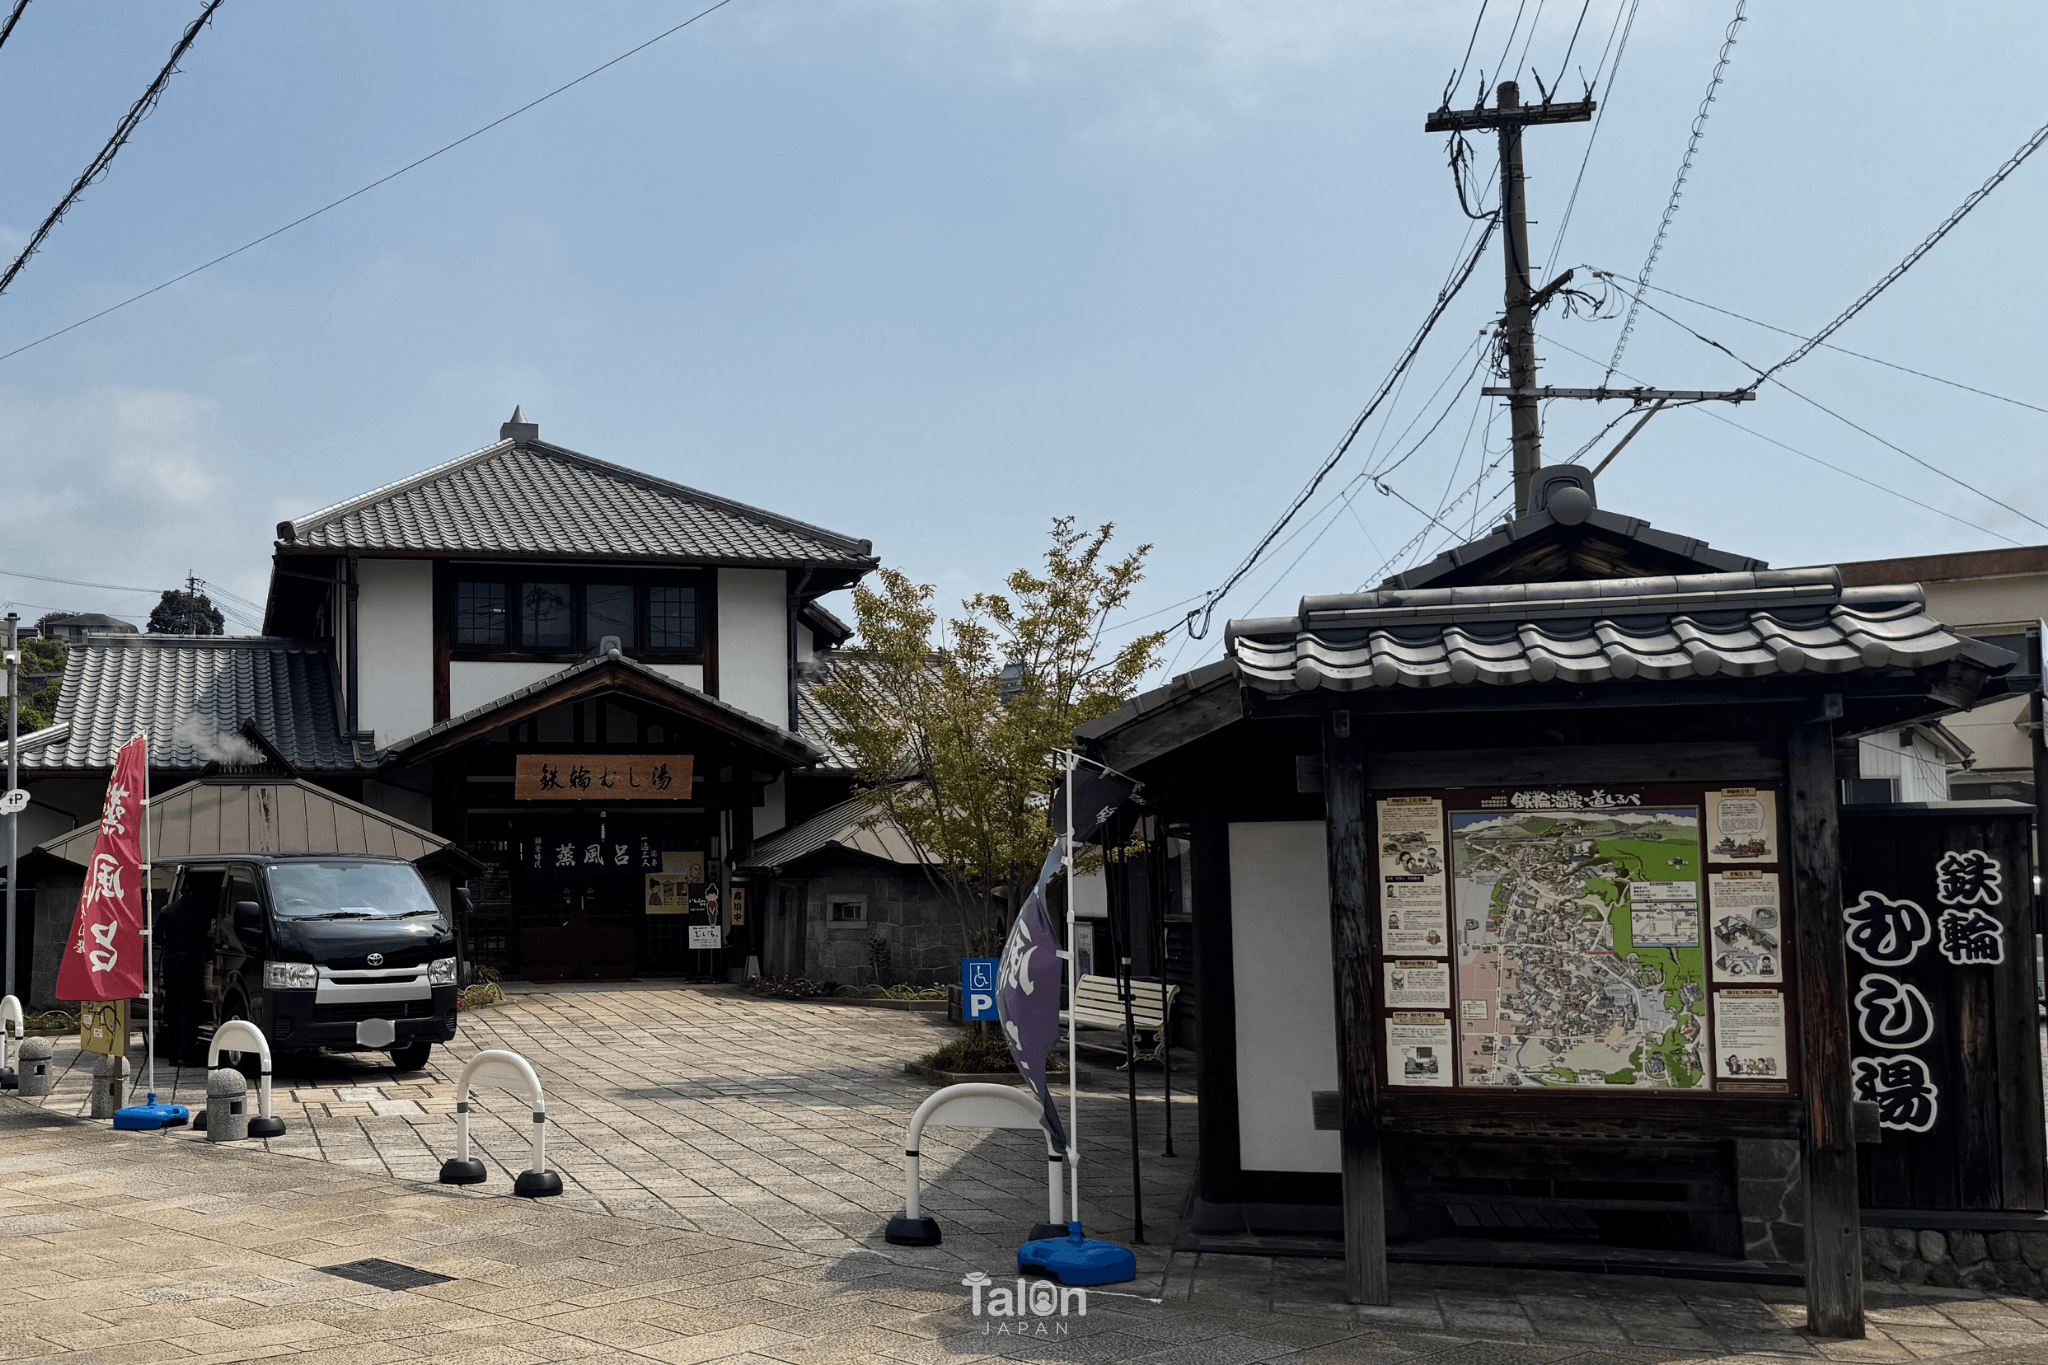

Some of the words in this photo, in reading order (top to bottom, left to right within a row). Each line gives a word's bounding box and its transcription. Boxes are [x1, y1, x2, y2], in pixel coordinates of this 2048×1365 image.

[540, 763, 673, 791] 鉄輪むし湯
[14, 793, 24, 805] P
[555, 842, 630, 867] 蒸風呂
[87, 782, 130, 972] 蒸風呂
[1936, 850, 2004, 965] 鉄輪
[970, 994, 993, 1017] P
[1843, 890, 1938, 1133] むし湯
